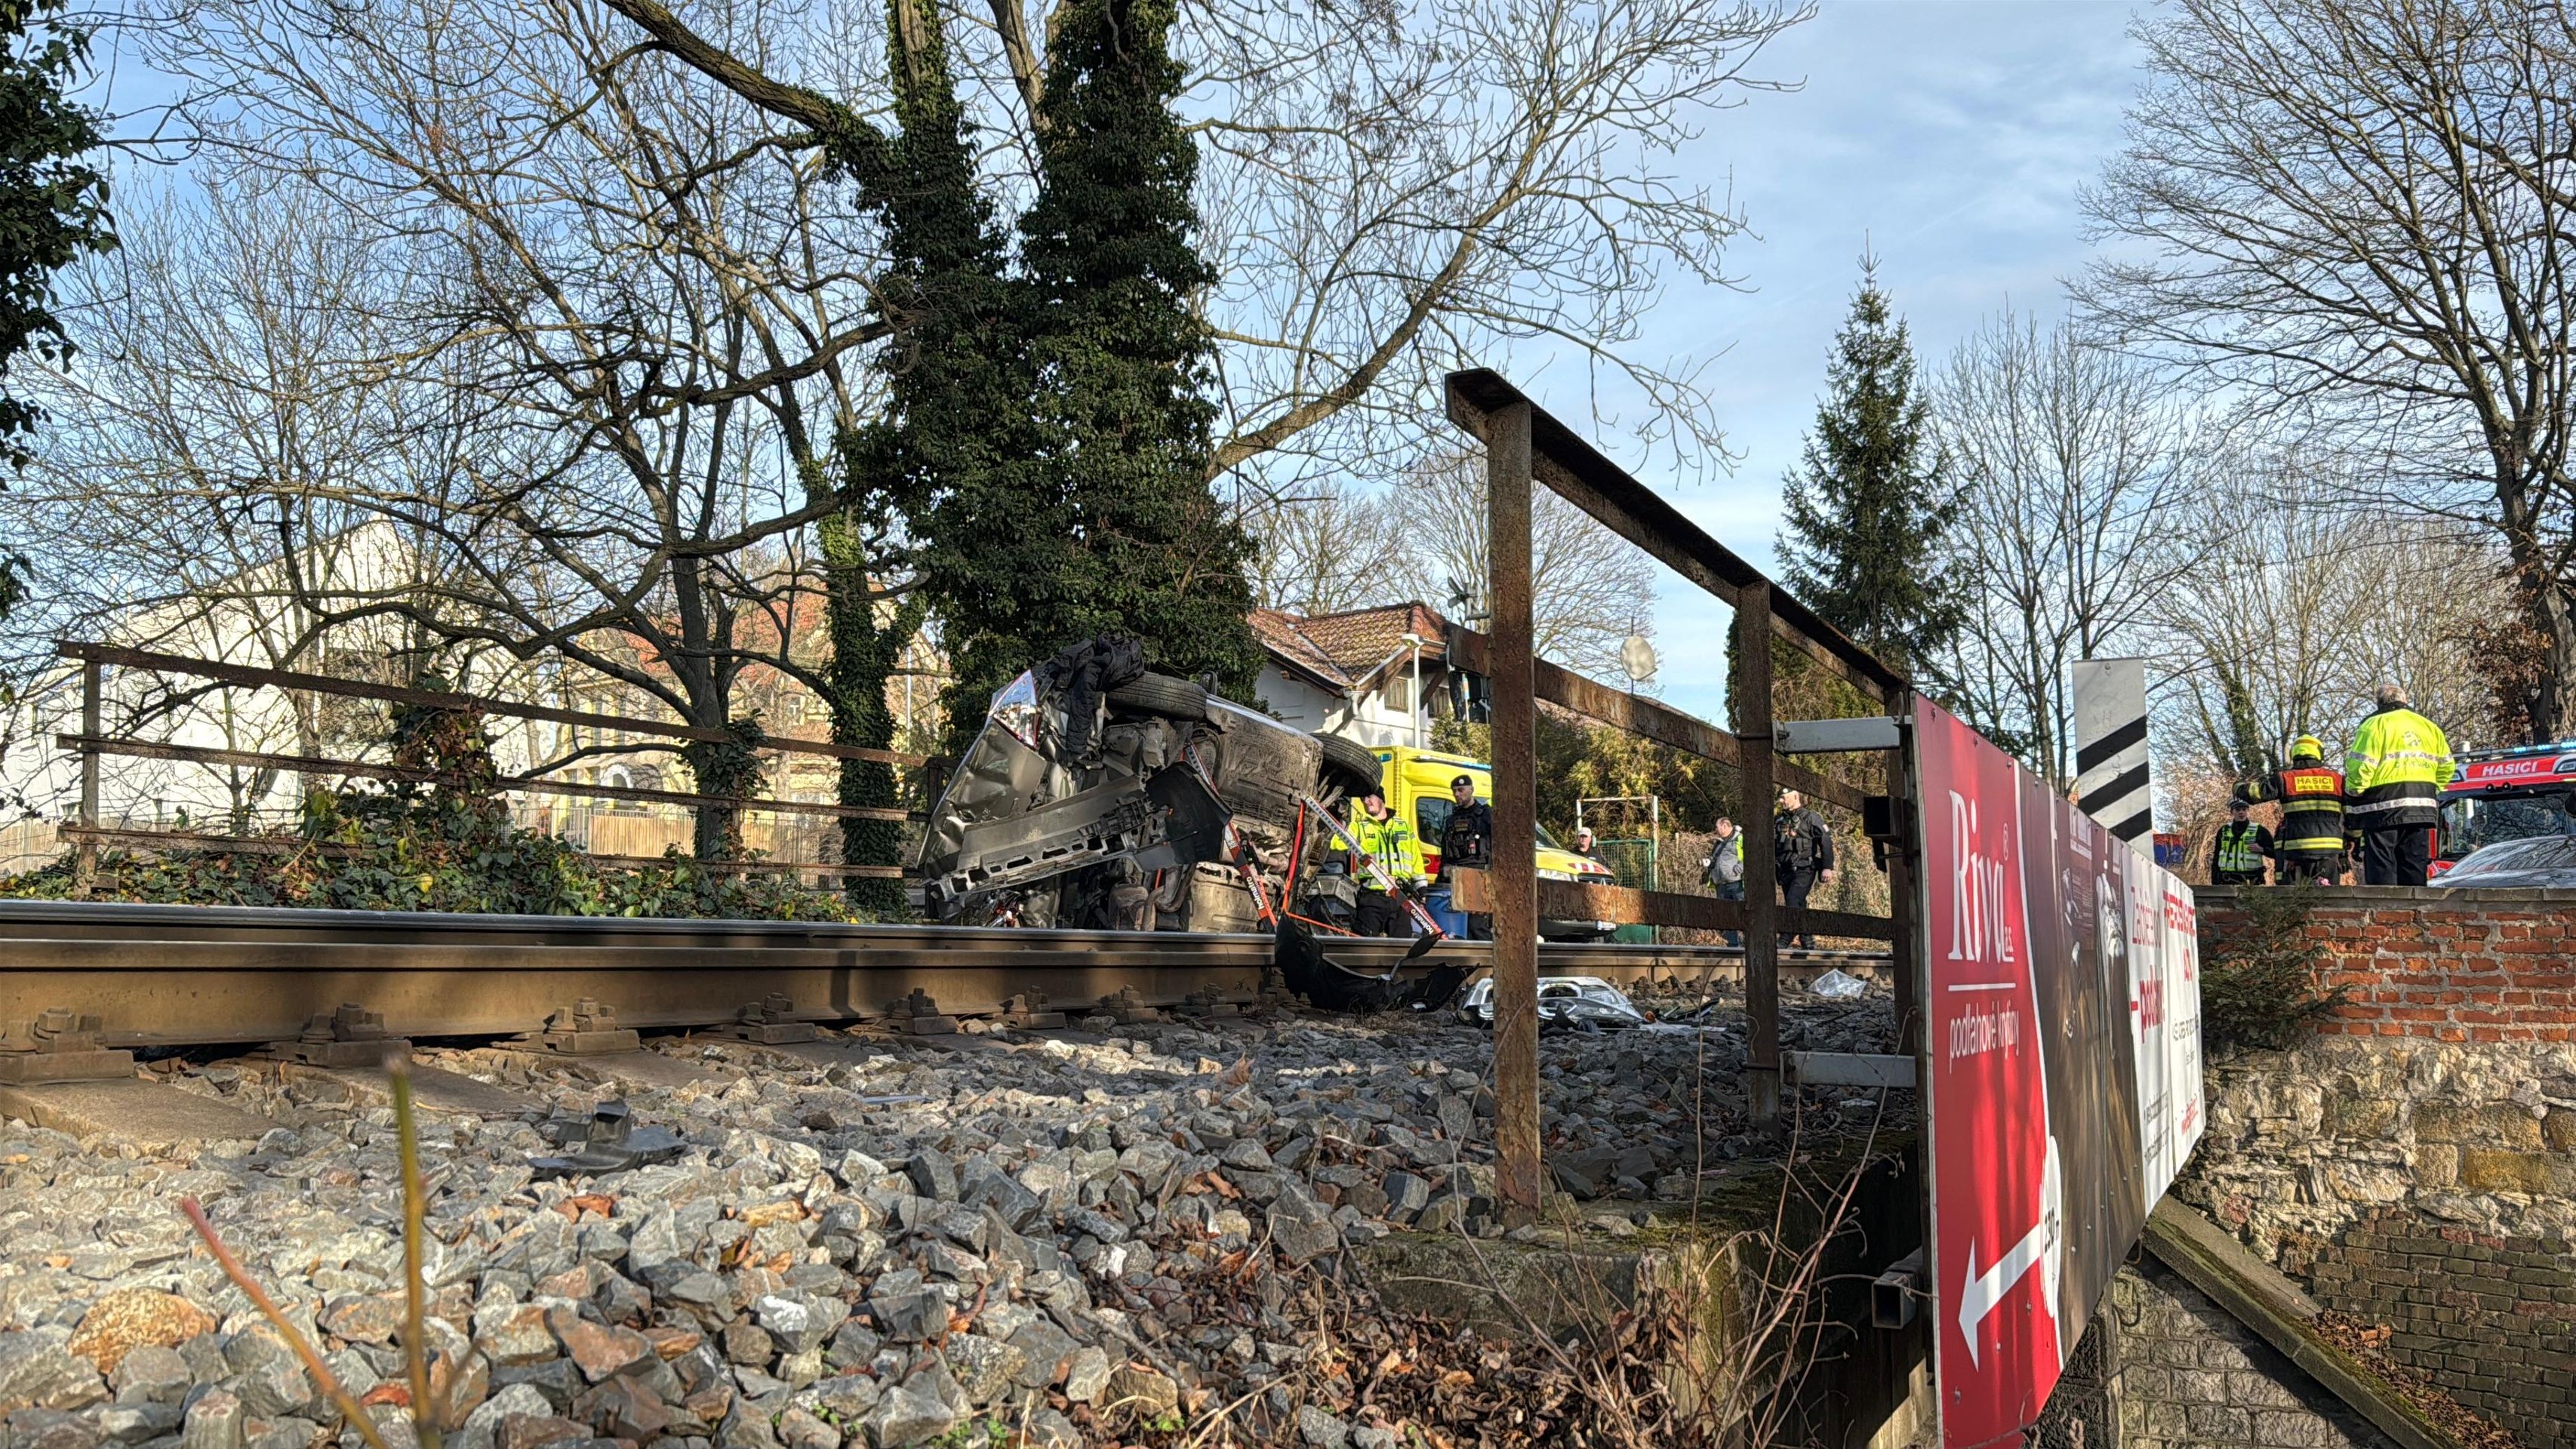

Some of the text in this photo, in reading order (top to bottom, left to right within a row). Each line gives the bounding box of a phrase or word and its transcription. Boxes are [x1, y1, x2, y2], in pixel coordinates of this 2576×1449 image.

[2482, 760, 2538, 777] HASIČI
[1245, 875, 1265, 910] holmatro
[1948, 789, 2014, 964] Riva
[1410, 908, 1434, 935] holmatro
[1950, 1001, 1996, 1075] podlahové
